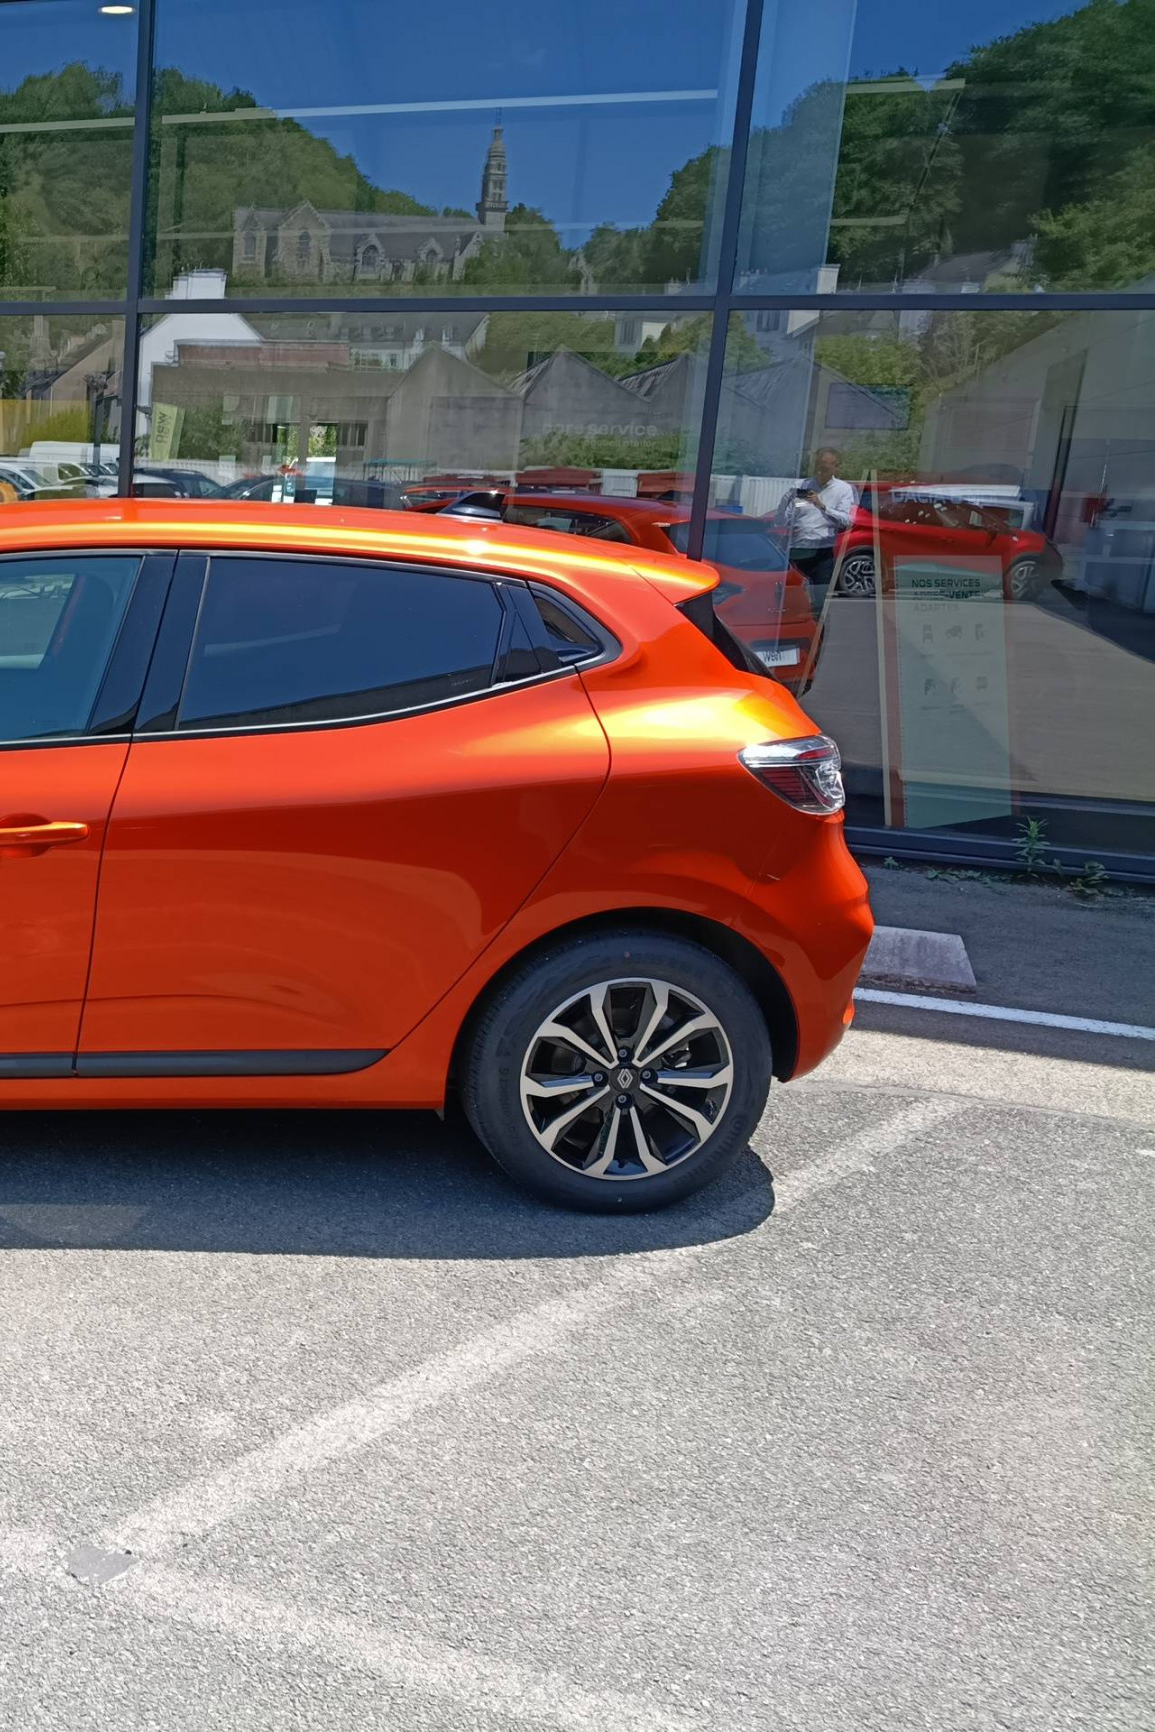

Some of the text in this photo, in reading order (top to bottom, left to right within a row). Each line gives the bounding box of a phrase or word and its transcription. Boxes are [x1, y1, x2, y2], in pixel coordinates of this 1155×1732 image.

[587, 421, 658, 436] service
[911, 578, 981, 588] NOS SERVICES
